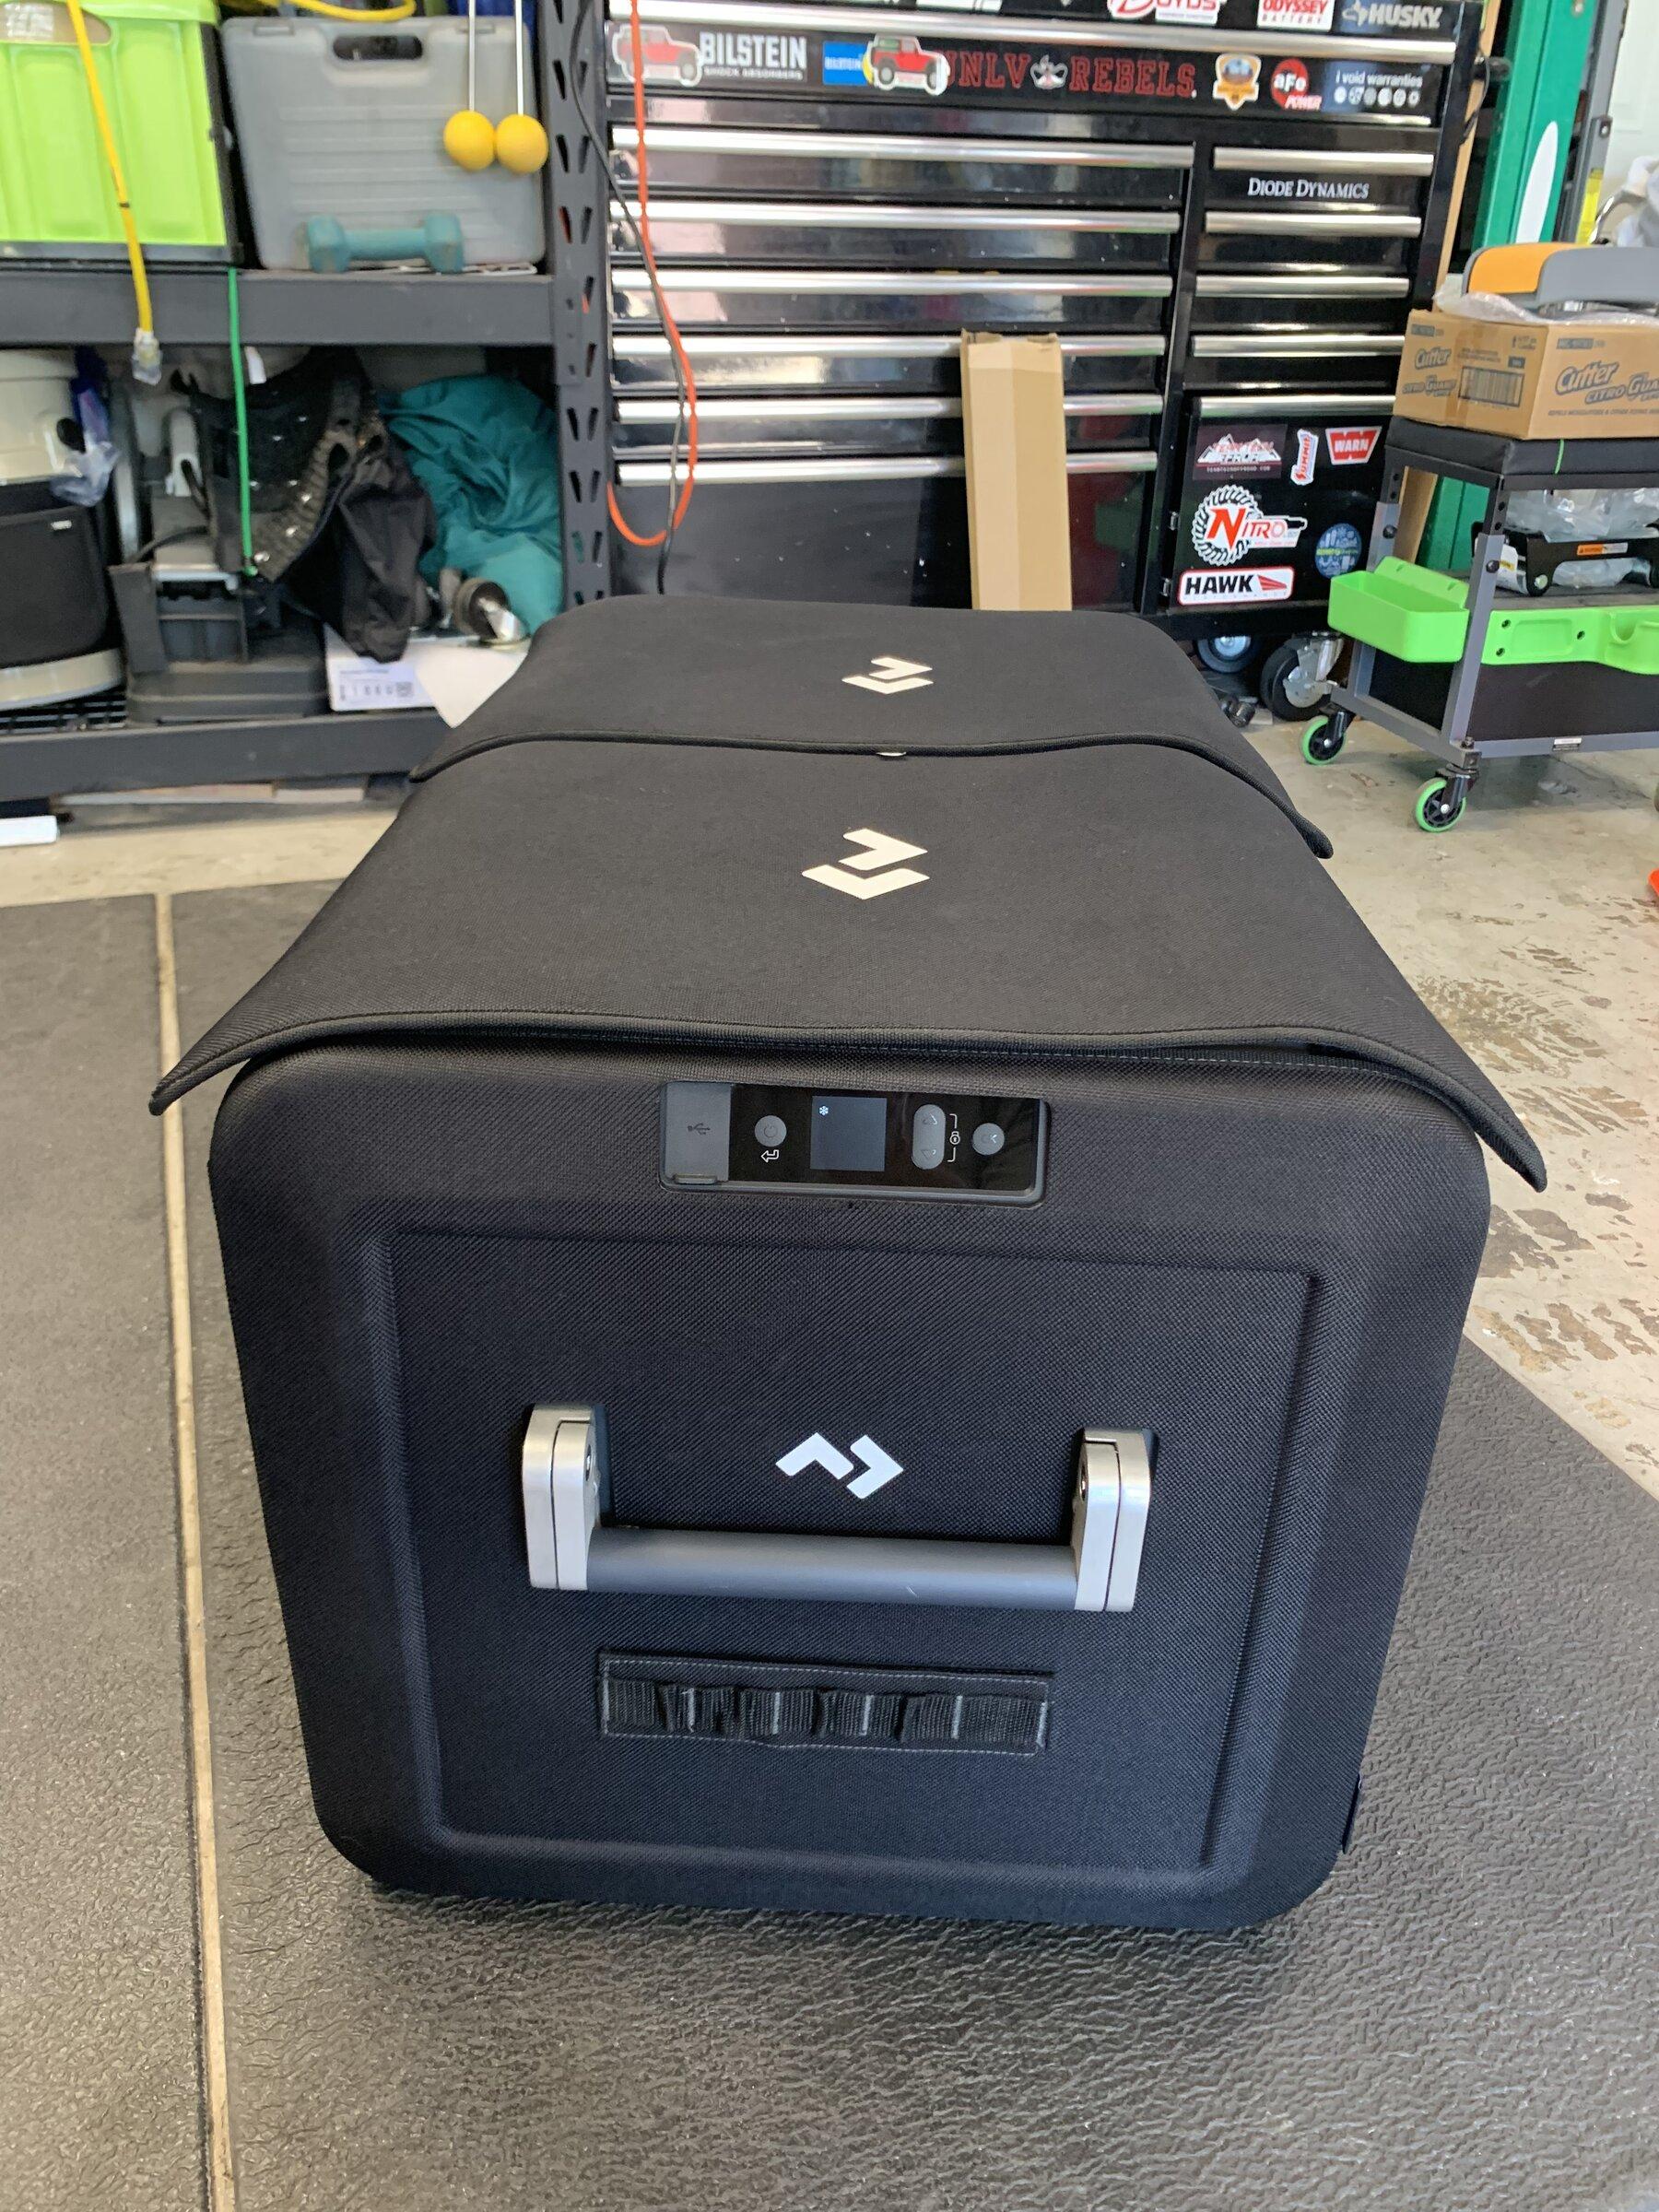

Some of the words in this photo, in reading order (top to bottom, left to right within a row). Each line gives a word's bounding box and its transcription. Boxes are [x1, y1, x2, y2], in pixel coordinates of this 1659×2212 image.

[1263, 0, 1328, 14] ODYSSEY
[1368, 3, 1442, 29] HUSKY
[700, 31, 807, 69] BILSTEIN
[1069, 55, 1197, 99] REBELS
[1247, 177, 1294, 196] DIODE
[1296, 179, 1370, 199] DYNAMICS
[1415, 347, 1453, 370] Cutter
[1555, 360, 1620, 395] Cutter
[1295, 434, 1312, 480] SUMMIT
[1334, 438, 1371, 453] WARN
[1206, 508, 1286, 550] NITRO
[1185, 574, 1254, 594] HAWK
